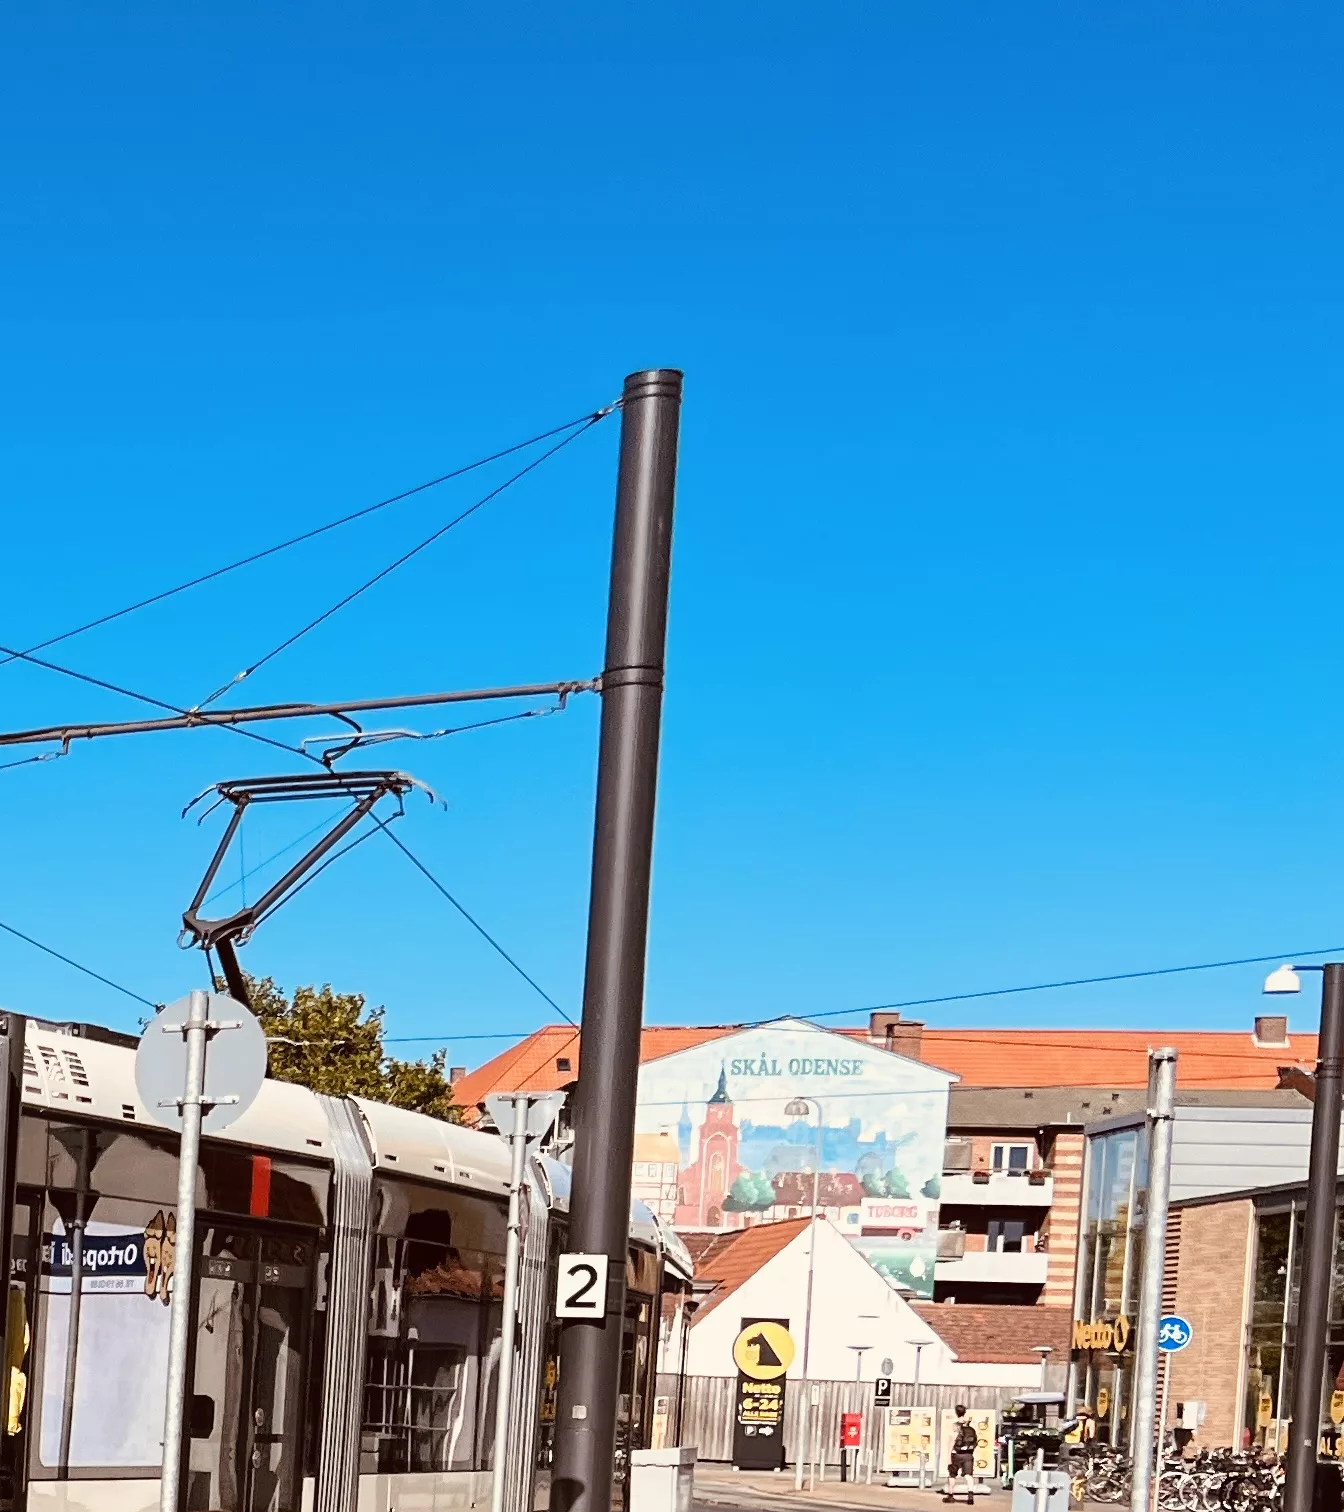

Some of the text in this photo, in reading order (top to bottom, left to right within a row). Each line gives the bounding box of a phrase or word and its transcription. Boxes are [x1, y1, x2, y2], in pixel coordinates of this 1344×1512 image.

[730, 1051, 864, 1076] SKÅL ODENSE
[565, 1264, 598, 1308] 2
[1073, 1320, 1111, 1350] Netto
